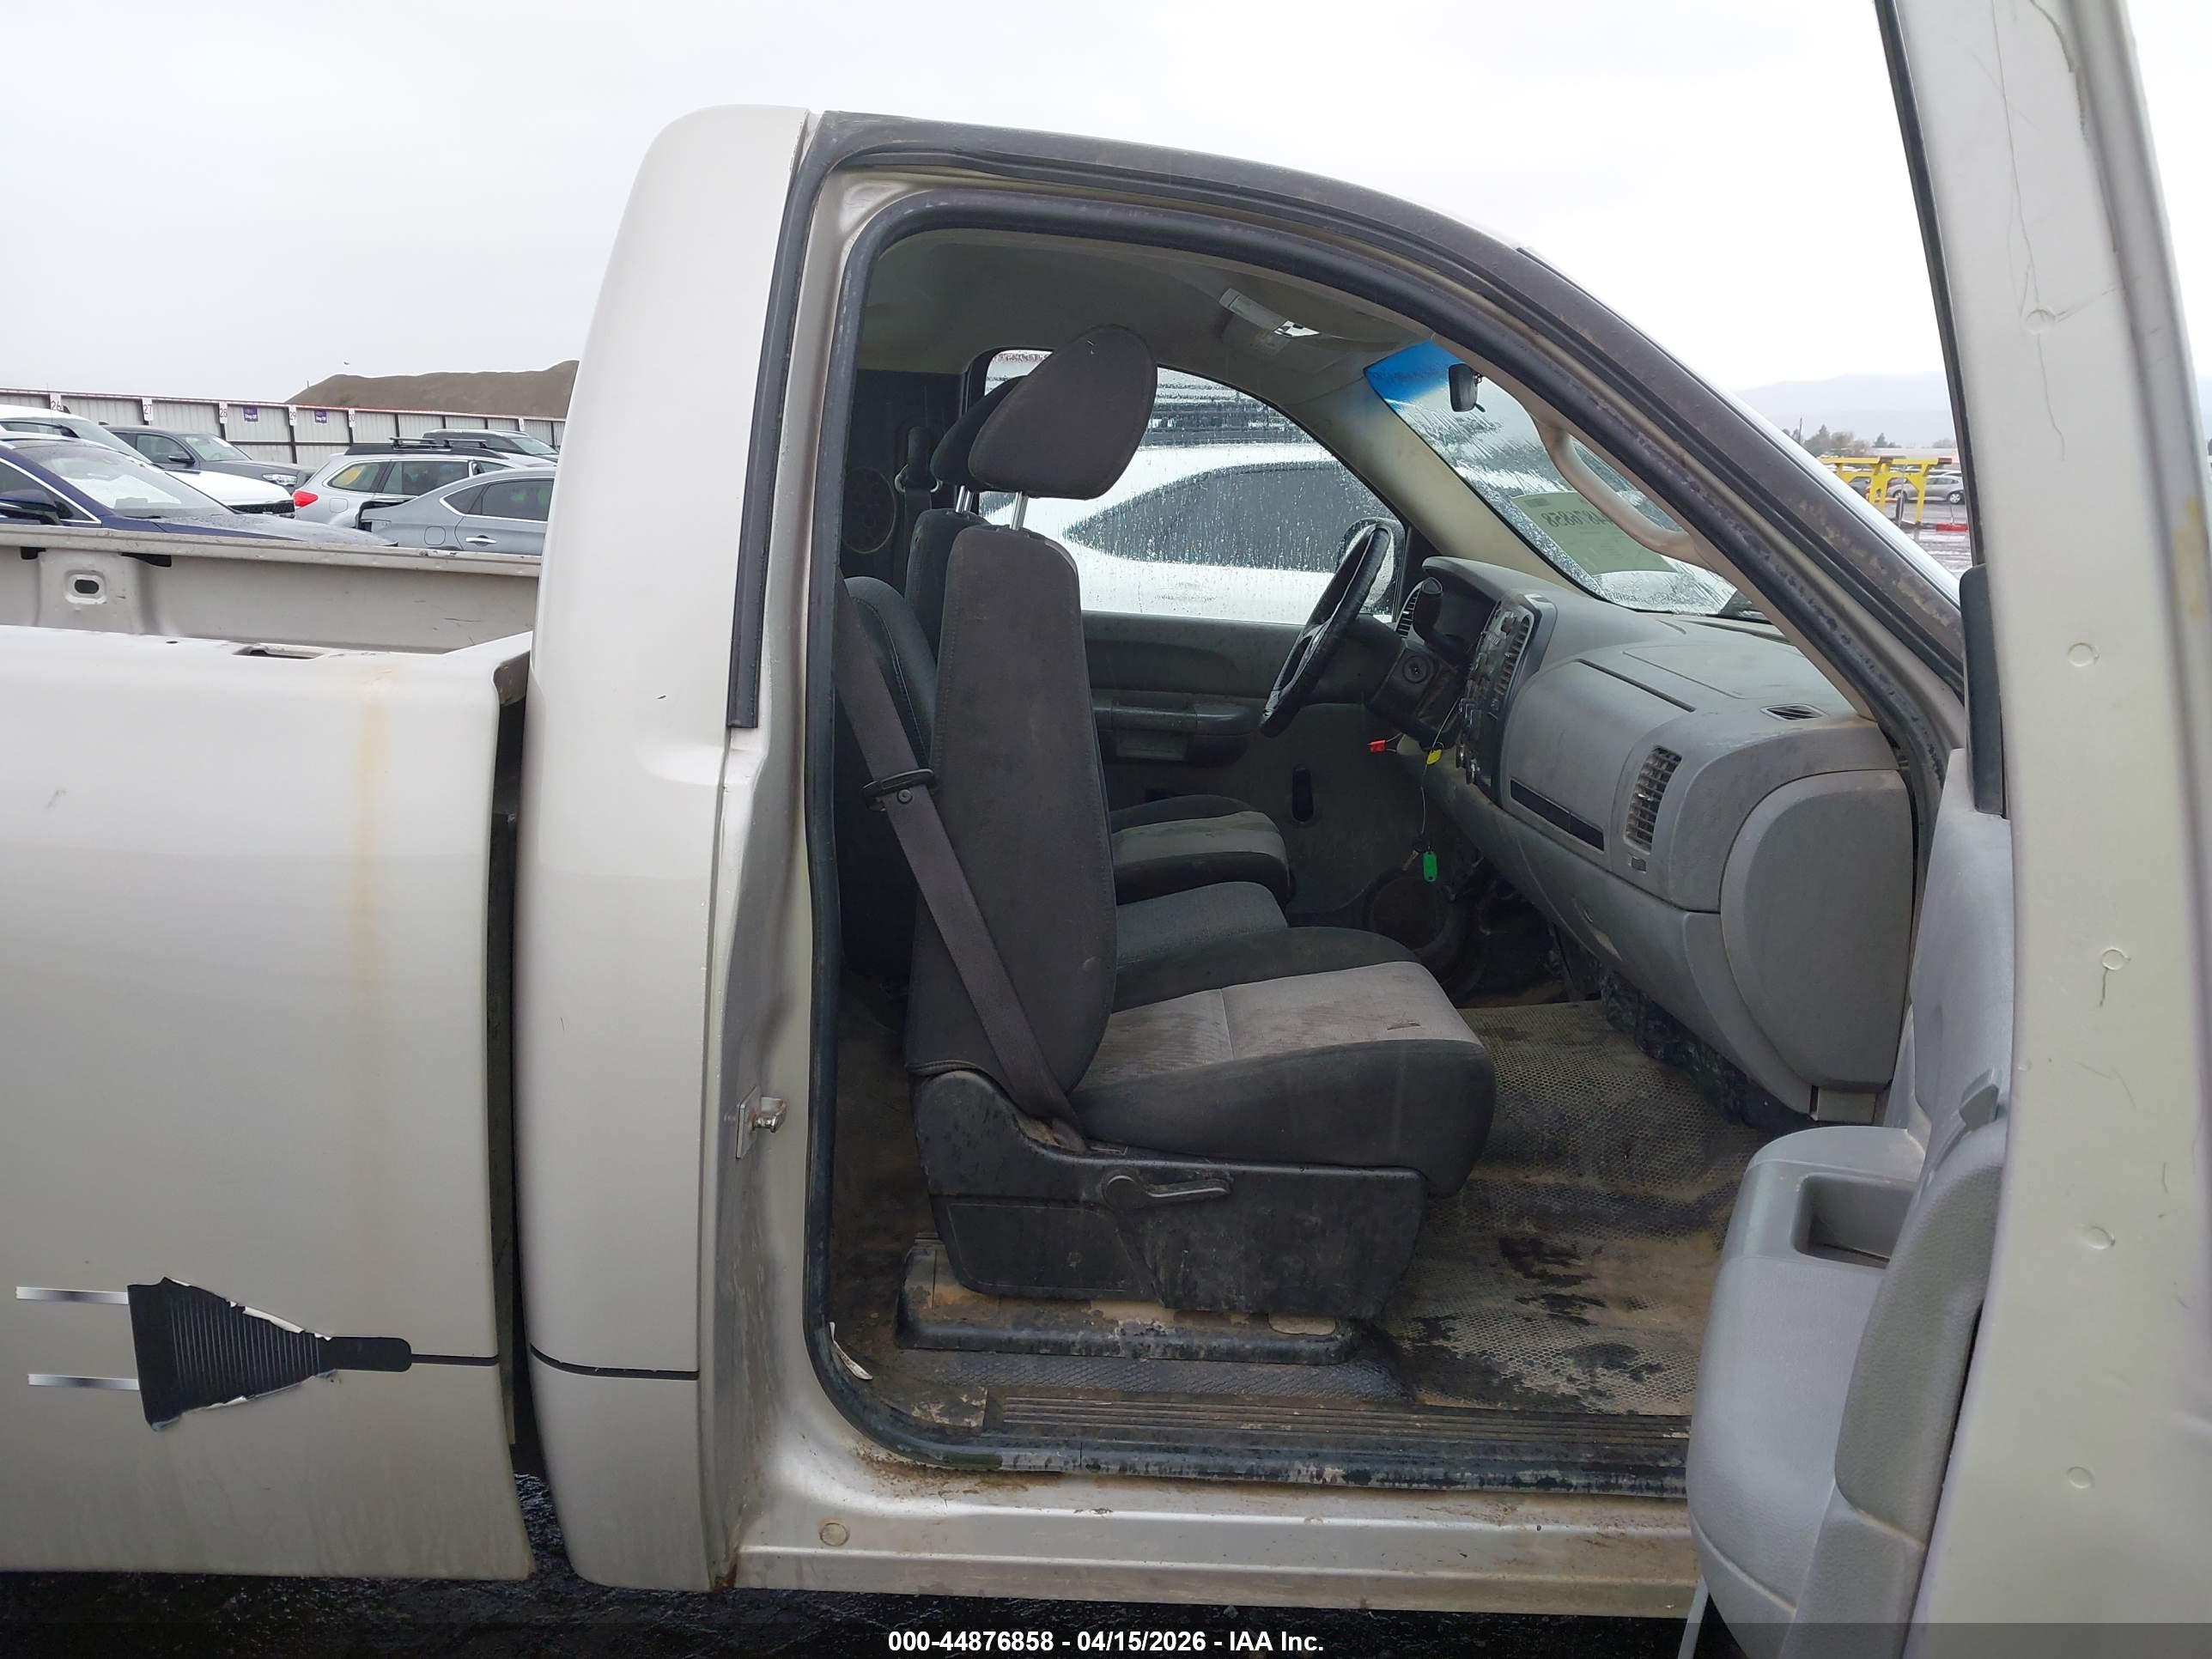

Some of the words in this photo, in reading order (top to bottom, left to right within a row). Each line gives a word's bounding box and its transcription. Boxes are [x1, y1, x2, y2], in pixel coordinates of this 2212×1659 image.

[51, 400, 62, 411] 26
[143, 404, 152, 415] 27
[289, 410, 296, 421] 29
